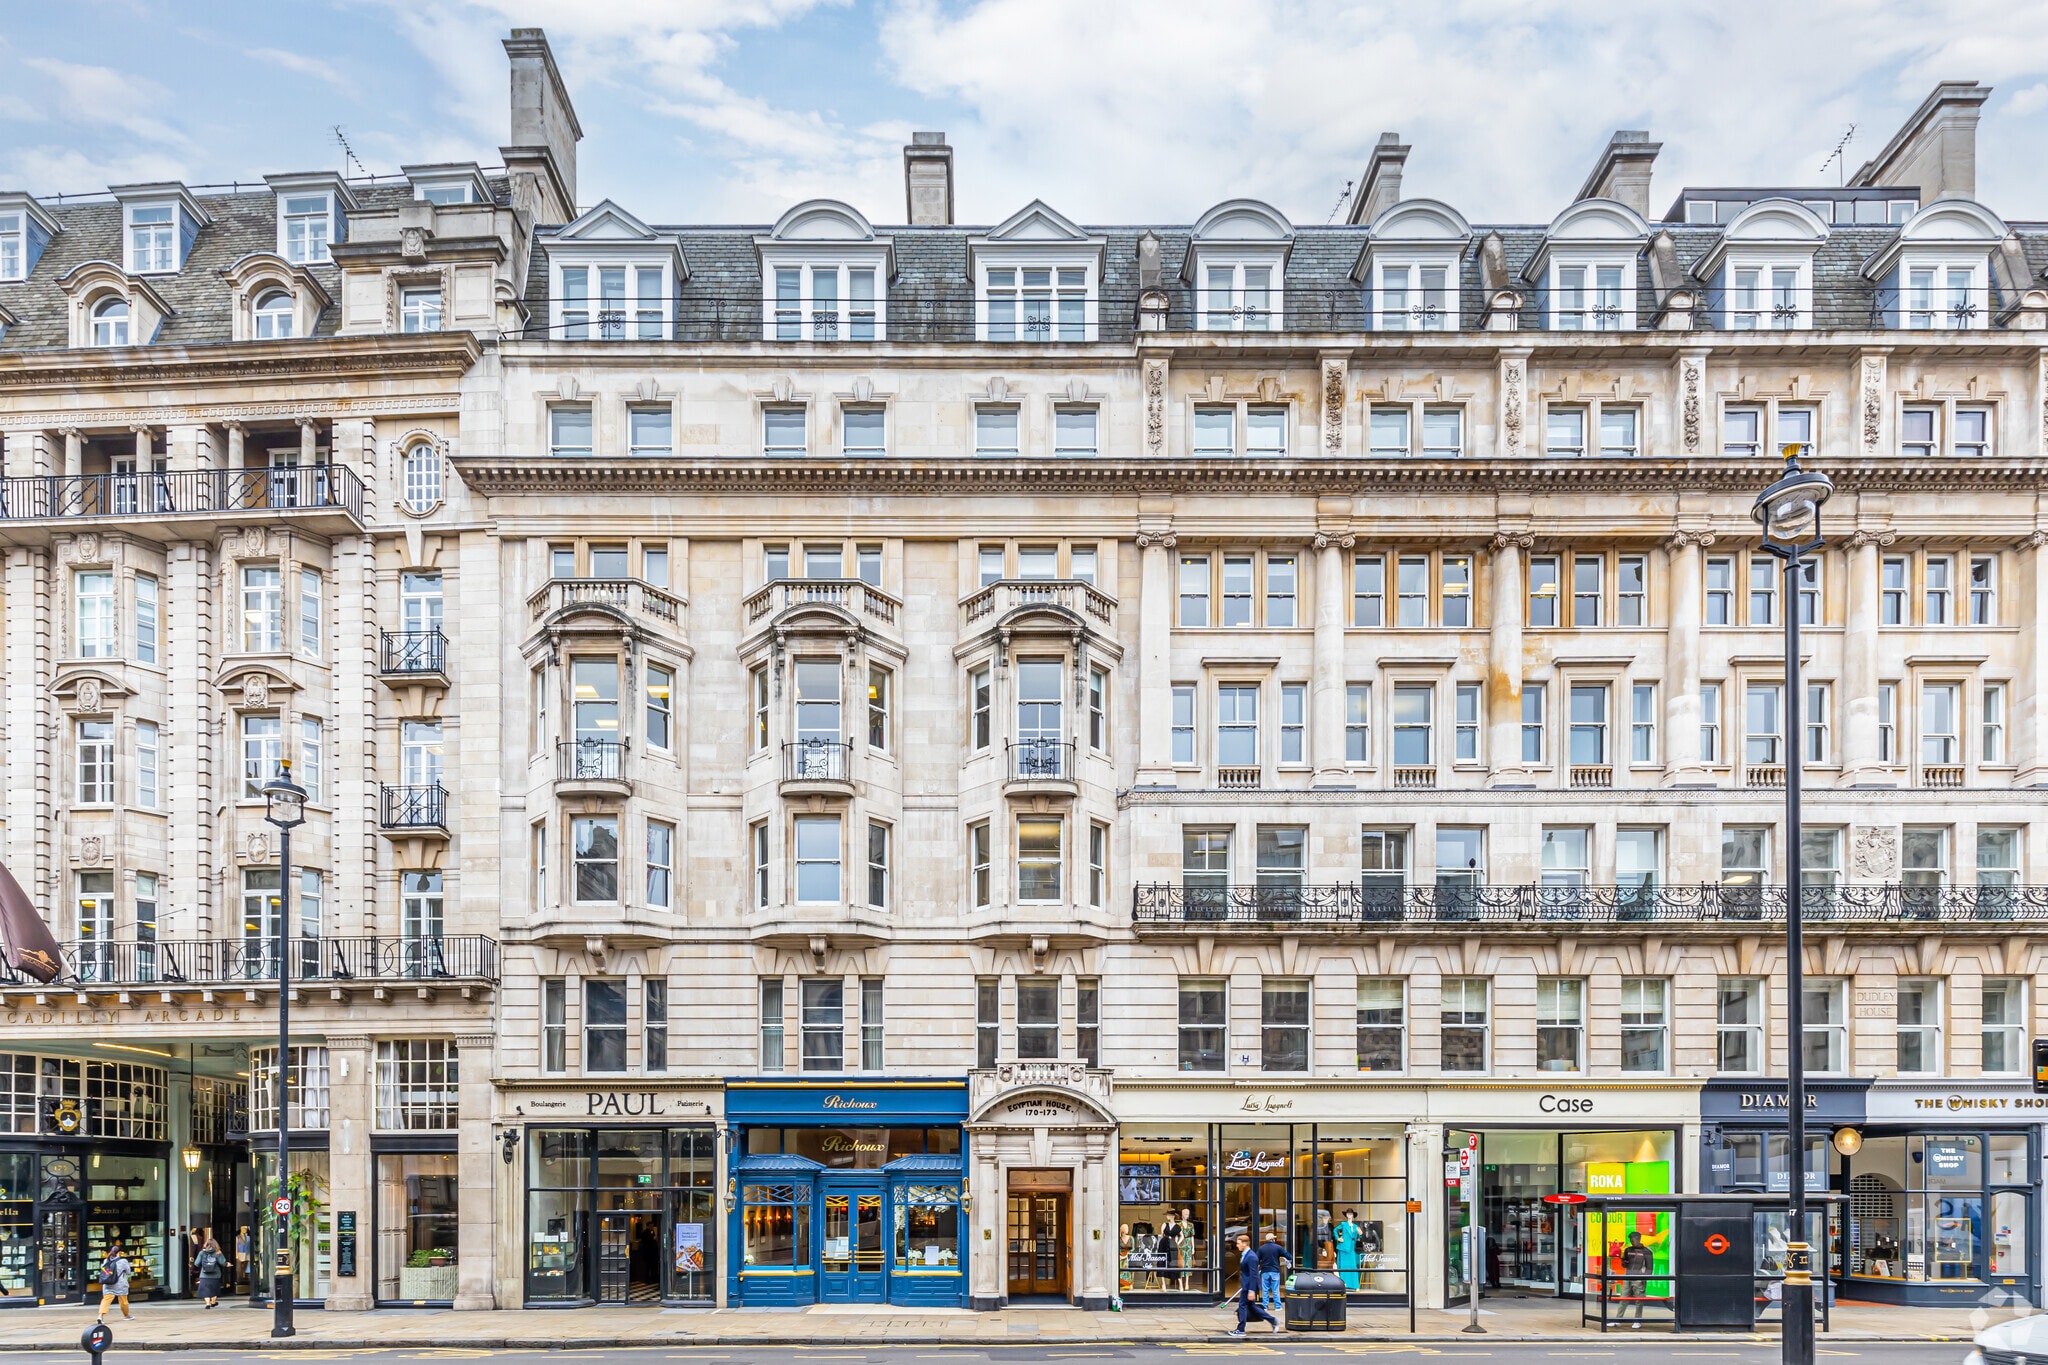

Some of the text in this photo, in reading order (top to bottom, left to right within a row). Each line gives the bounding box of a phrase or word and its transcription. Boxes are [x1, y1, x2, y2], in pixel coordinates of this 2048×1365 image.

[1856, 992, 1897, 1002] DUDLEY
[144, 1009, 241, 1022] ARCADE
[1859, 1007, 1892, 1017] HOUSE
[530, 1100, 566, 1108] Boulangerie
[586, 1092, 666, 1116] PAUL
[822, 1094, 878, 1109] Richoux
[1007, 1099, 1043, 1113] EGYPTIAN
[1240, 1094, 1293, 1114] Luisa Spagnoli
[1539, 1094, 1594, 1113] Case
[1741, 1093, 1818, 1108] DIAMR
[1915, 1098, 1944, 1109] THE
[1948, 1097, 2009, 1110] WHISKY
[821, 1135, 886, 1152] Richoux
[1469, 1135, 1475, 1146] G
[1226, 1151, 1285, 1173] Luisa Spagnoli
[1932, 1153, 1965, 1163] WHISKY
[1590, 1174, 1623, 1188] ROKA
[92, 1205, 121, 1216] Santa
[277, 1202, 290, 1211] 20
[1590, 1212, 1623, 1224] COOUR
[1142, 1253, 1167, 1262] Season
